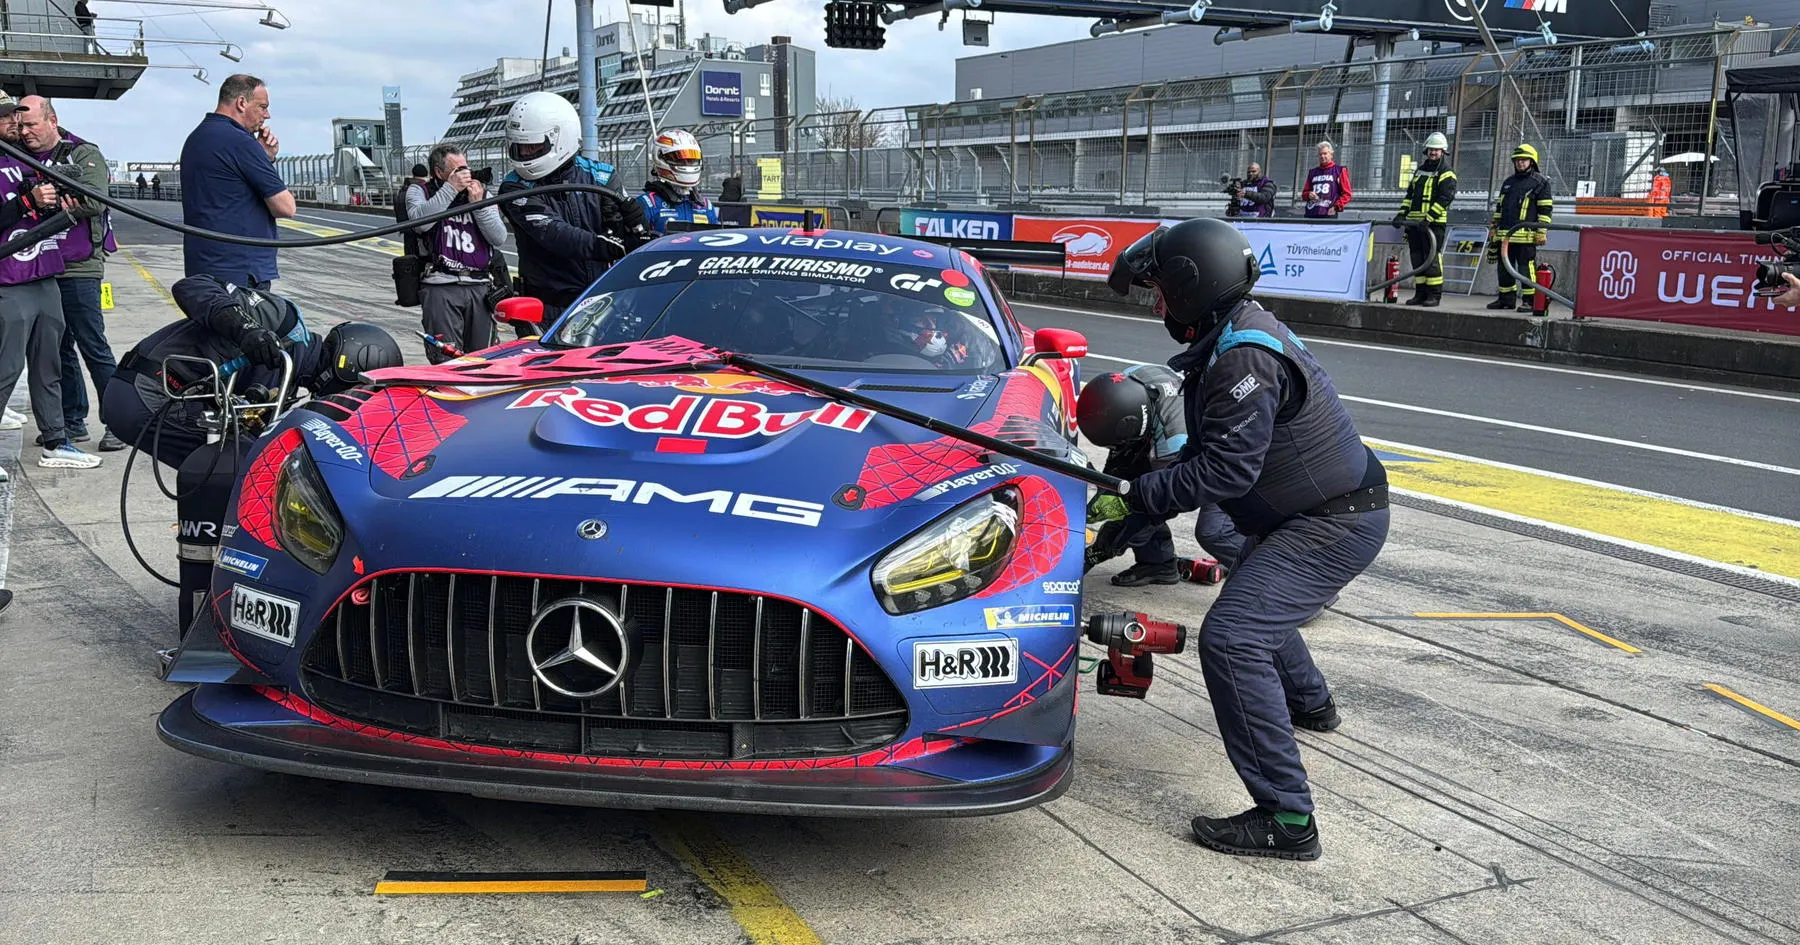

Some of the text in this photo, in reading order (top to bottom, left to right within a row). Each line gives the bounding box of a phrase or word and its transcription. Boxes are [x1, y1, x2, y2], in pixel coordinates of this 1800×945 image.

[705, 85, 740, 95] Dorint
[0, 166, 23, 183] TV
[763, 175, 780, 183] TART
[1312, 174, 1334, 183] MEDIA
[1584, 182, 1591, 194] 1
[915, 216, 1000, 240] FALKEN
[444, 225, 475, 253] 118
[759, 234, 903, 255] viaplay
[698, 256, 767, 270] GRAN
[1661, 249, 1785, 265] OFFICIAL TIMIN
[801, 272, 866, 284] SIMULATOR
[1285, 264, 1305, 277] FSP
[1233, 376, 1258, 400] OMP
[506, 386, 877, 439] Red Bull
[530, 476, 824, 528] AMG
[222, 555, 259, 572] MICHELIN
[1042, 581, 1079, 592] sparco
[233, 592, 268, 631] H&R
[1018, 611, 1070, 622] MICHELIN
[919, 649, 979, 680] H&R
